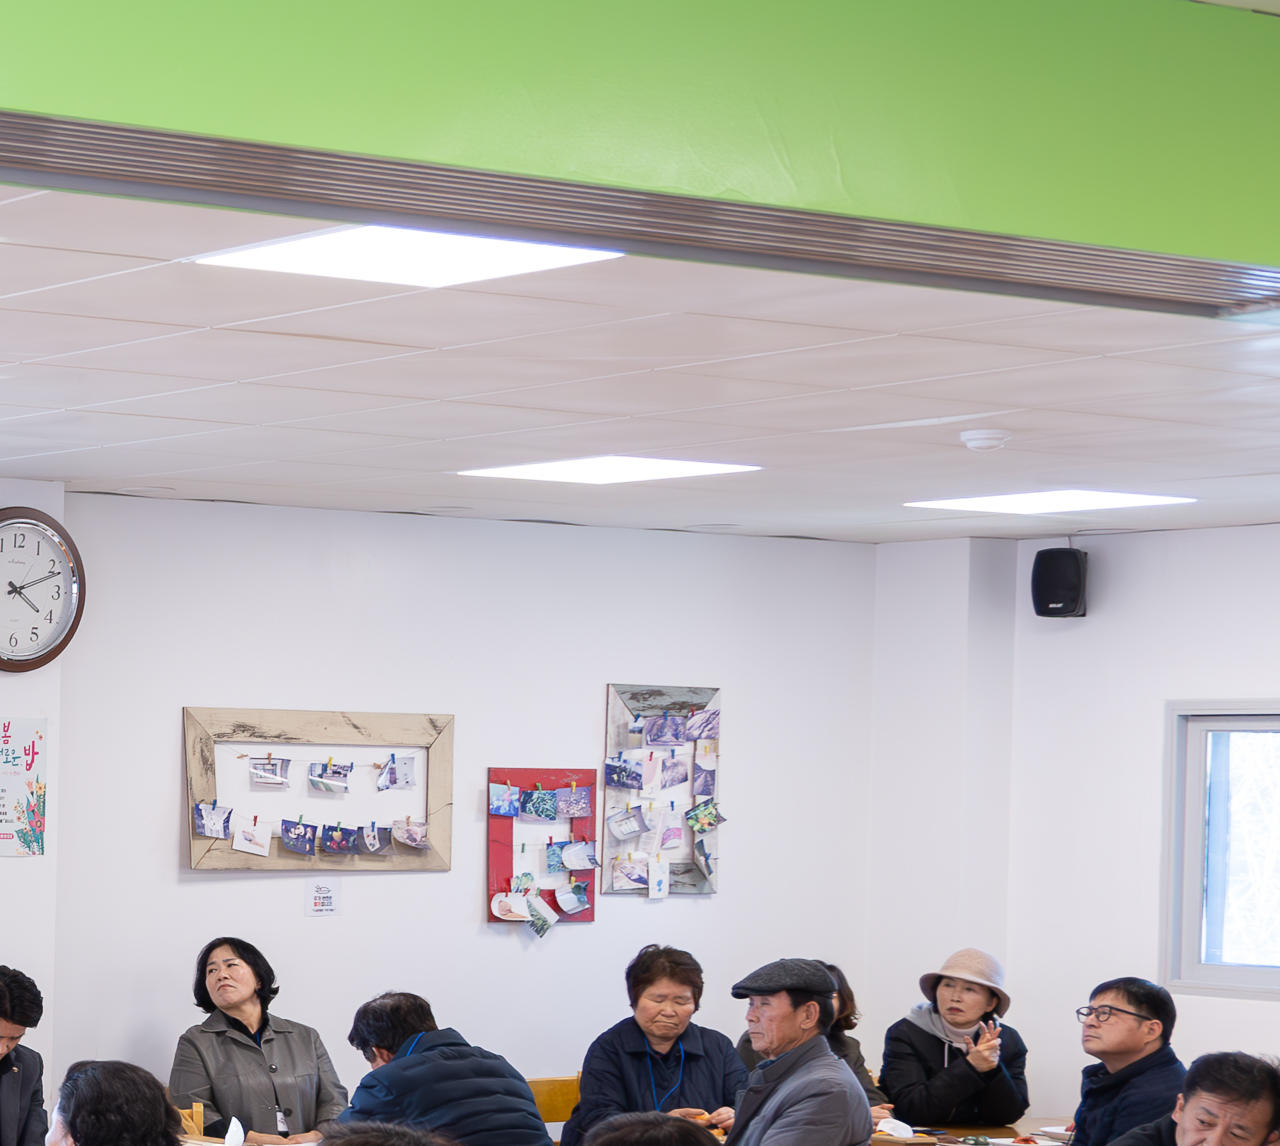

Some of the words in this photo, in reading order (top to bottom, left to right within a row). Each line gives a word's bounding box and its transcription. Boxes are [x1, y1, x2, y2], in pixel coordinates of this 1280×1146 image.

[13, 533, 26, 549] 12
[36, 540, 41, 556] 1
[47, 558, 57, 574] 2
[51, 584, 61, 601] 3
[43, 609, 53, 624] 4
[9, 631, 18, 648] 6
[29, 626, 39, 642] 5
[1, 721, 12, 745] 봄
[24, 740, 39, 771] 밥
